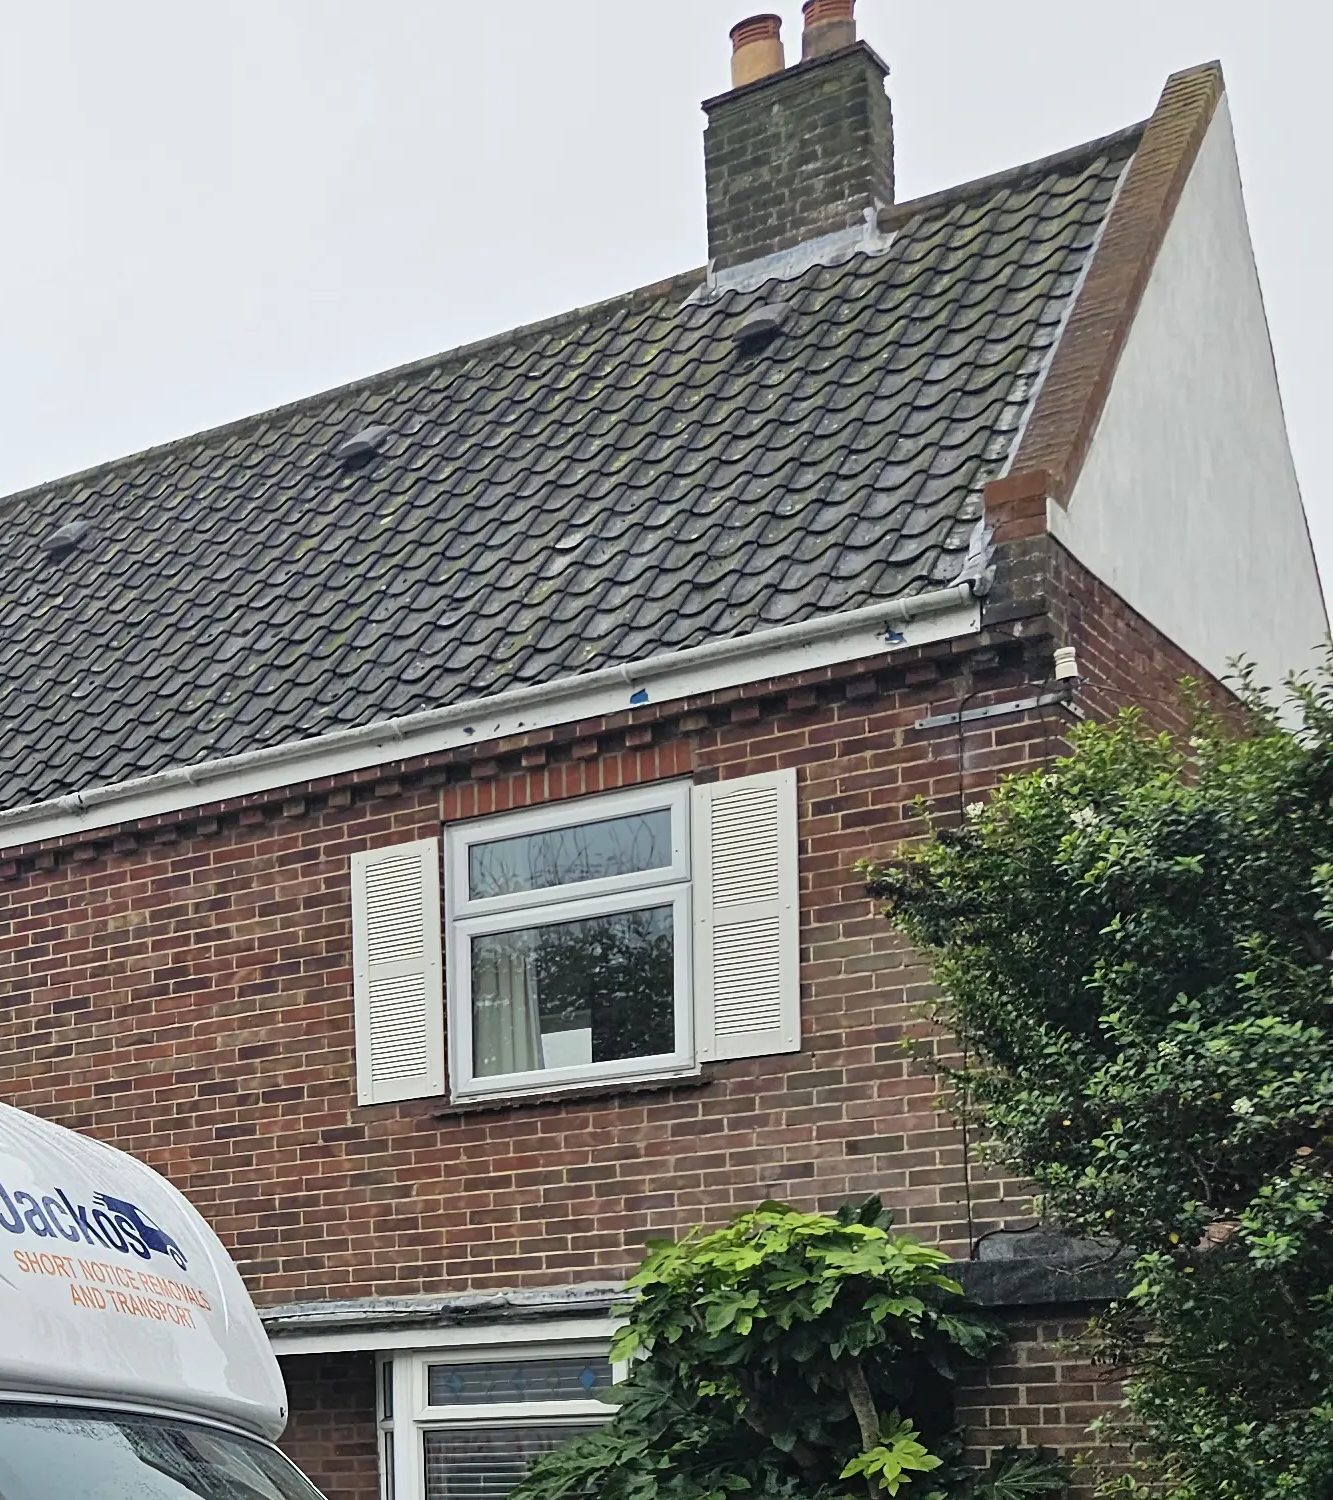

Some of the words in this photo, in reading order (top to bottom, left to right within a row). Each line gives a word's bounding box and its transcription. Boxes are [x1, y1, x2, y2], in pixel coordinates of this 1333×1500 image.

[13, 1249, 77, 1279] SHORT
[78, 1258, 141, 1291] NOTICE
[137, 1271, 212, 1312] REMOVALS
[70, 1283, 107, 1310] AND
[106, 1289, 197, 1330] TRANSPORT
